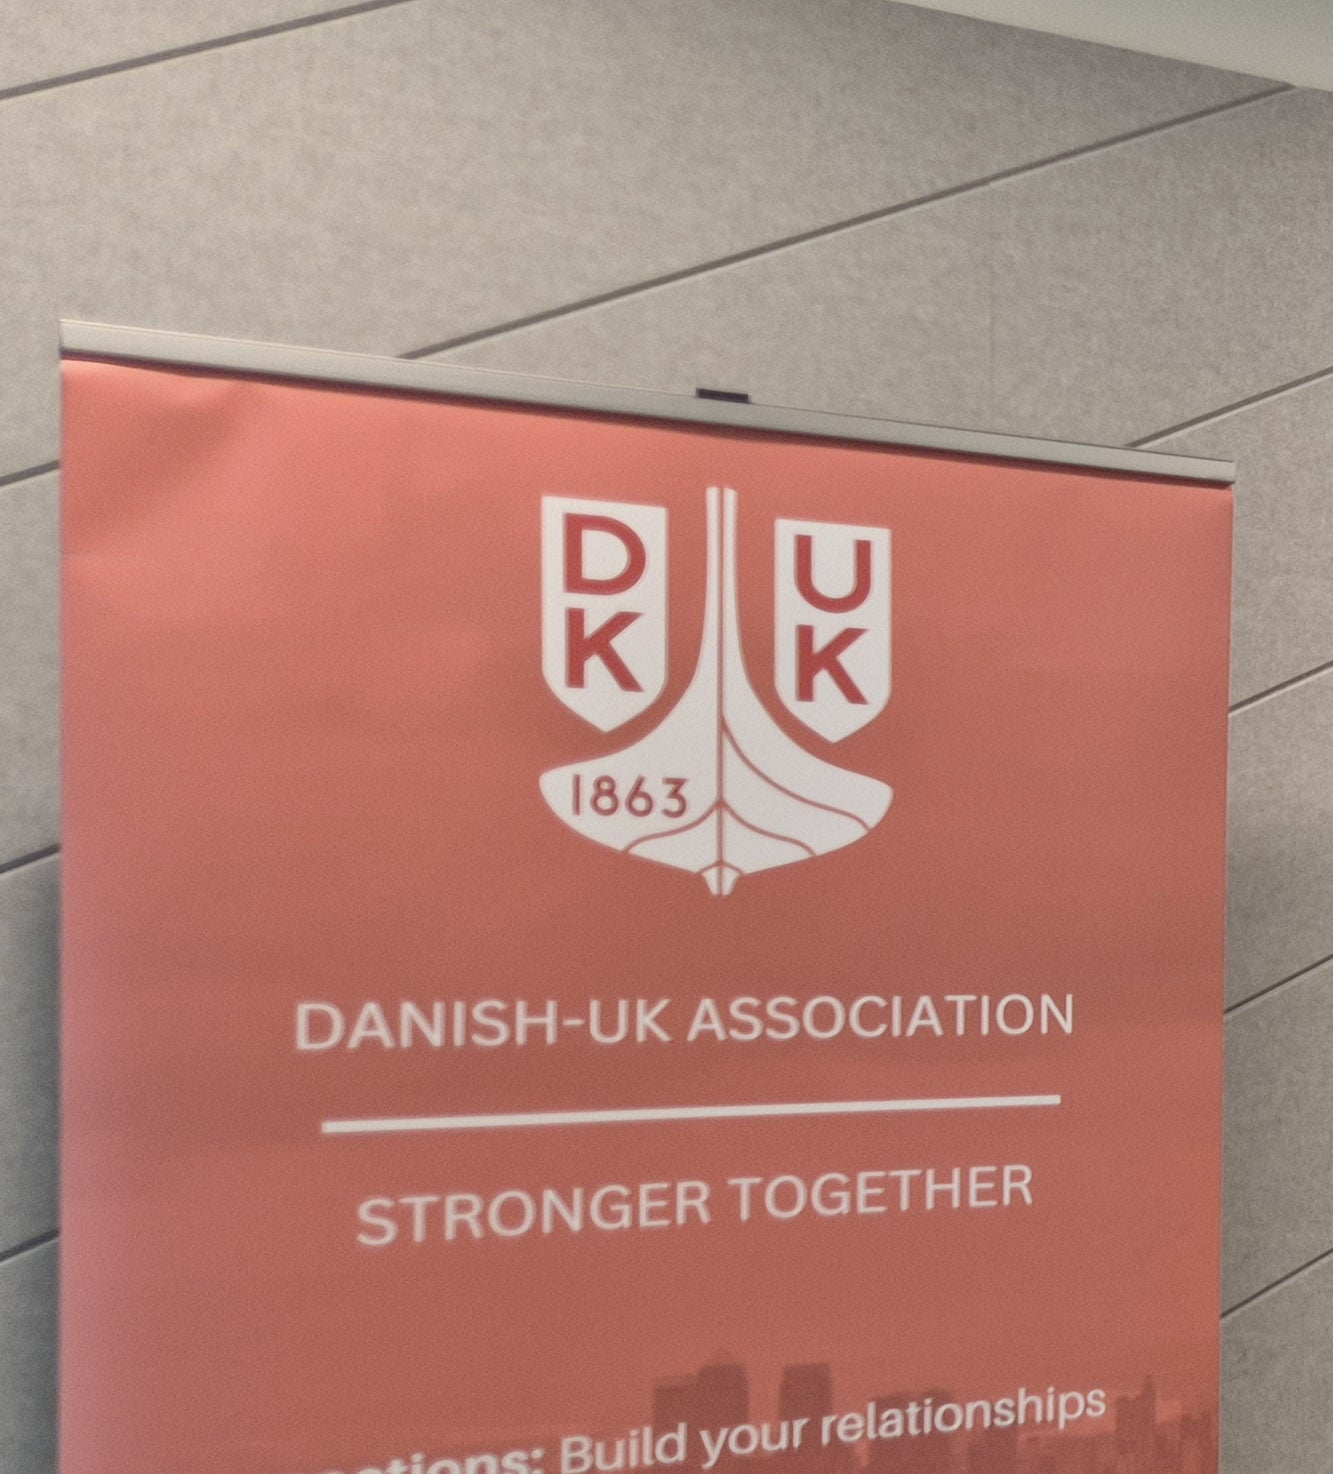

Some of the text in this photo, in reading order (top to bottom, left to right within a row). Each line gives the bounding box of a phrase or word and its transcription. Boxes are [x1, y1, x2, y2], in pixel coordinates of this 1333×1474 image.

[562, 511, 648, 694] DK
[793, 533, 873, 706] UK
[571, 773, 689, 819] 1863
[294, 993, 1074, 1051] DANISH-UK ASSOCIATION
[355, 1164, 1034, 1247] STRONGER TOGETHER
[560, 1422, 687, 1474] Build
[699, 1418, 809, 1469] your
[820, 1386, 1108, 1445] relationships
